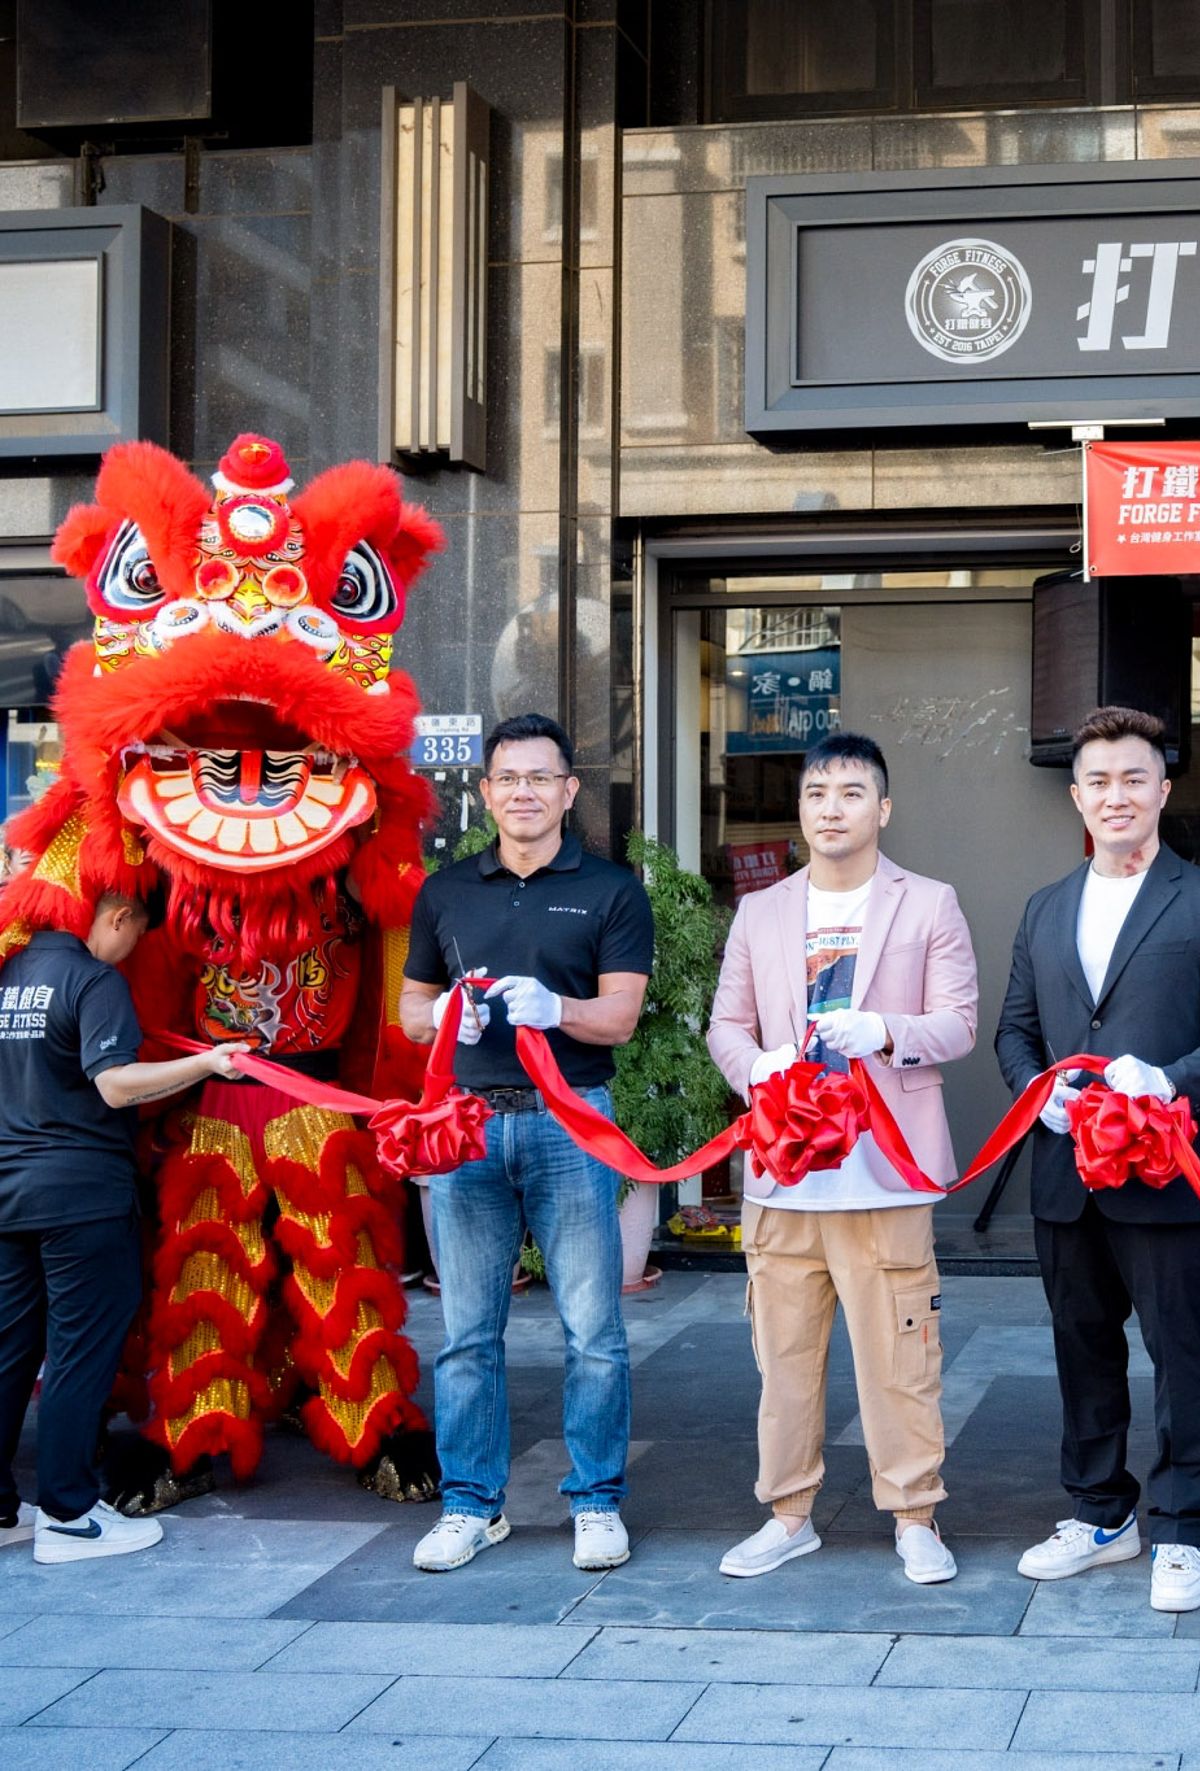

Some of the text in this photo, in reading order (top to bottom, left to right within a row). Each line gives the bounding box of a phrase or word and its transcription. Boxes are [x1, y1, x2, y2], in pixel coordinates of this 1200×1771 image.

[929, 249, 1007, 277] FORGE FITNESS
[933, 330, 1005, 352] EST 2016 TAIPEI
[1118, 503, 1181, 525] FORGE
[423, 736, 472, 762] 335
[548, 906, 588, 915] MATRIX
[0, 985, 54, 1010] 鐵健身
